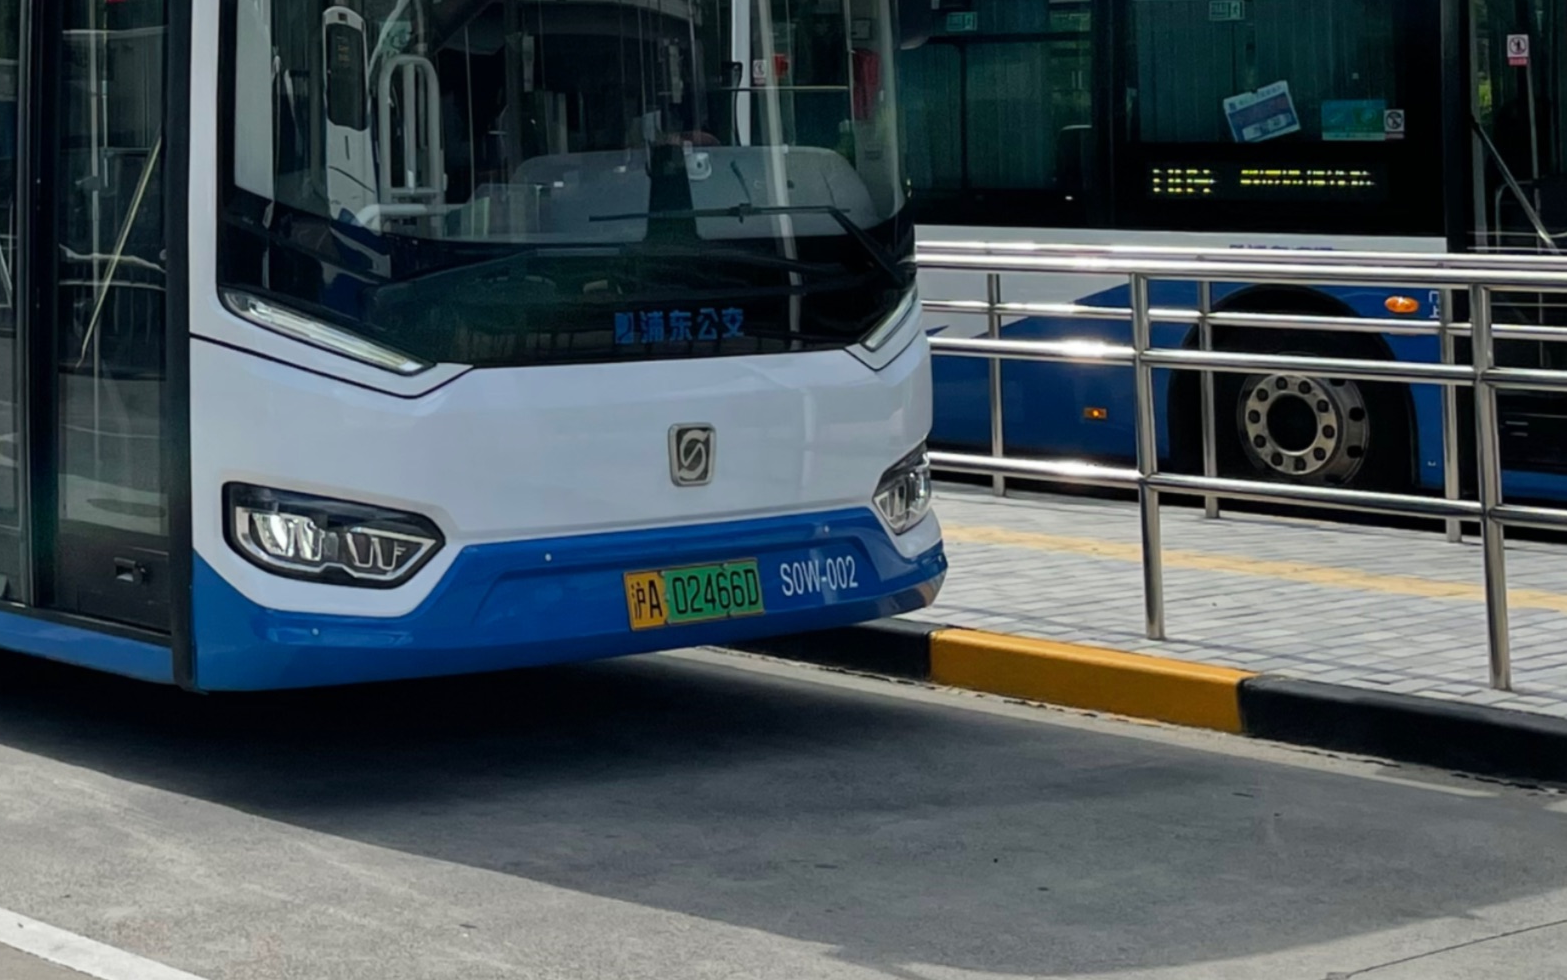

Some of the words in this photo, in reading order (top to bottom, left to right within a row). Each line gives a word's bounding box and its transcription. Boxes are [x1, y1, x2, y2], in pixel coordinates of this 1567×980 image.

[639, 307, 745, 344] 浦东公交
[630, 579, 664, 620] 沪A
[671, 568, 760, 616] 02466D
